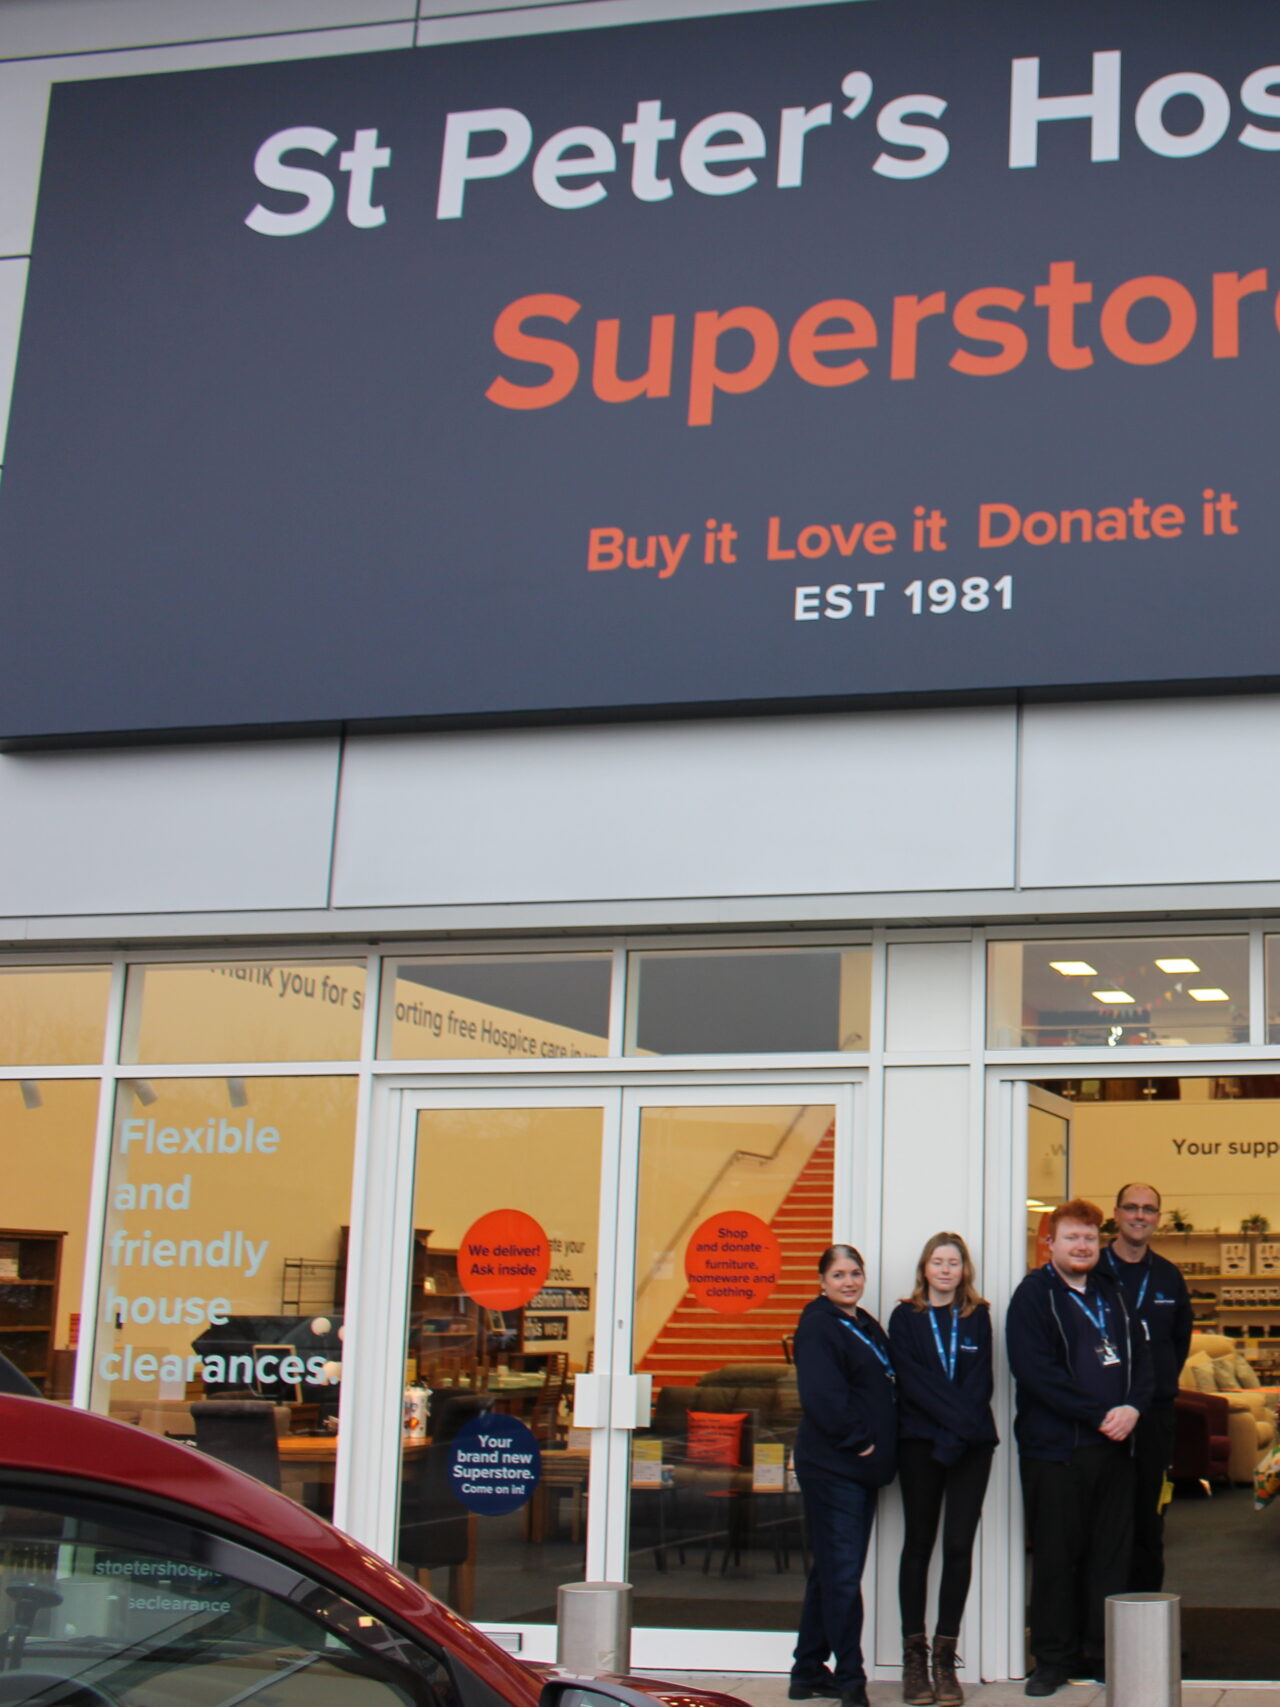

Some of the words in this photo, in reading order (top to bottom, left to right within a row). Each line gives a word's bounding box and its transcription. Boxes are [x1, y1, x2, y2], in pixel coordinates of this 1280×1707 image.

[244, 125, 391, 237] St
[435, 71, 951, 220] Peter’s
[586, 524, 691, 579] Buy
[704, 519, 738, 565] it
[766, 511, 897, 562] Love
[913, 506, 948, 553] it
[978, 496, 1185, 548] Donate
[1201, 489, 1239, 537] it
[794, 582, 885, 622] EST
[903, 574, 1014, 615] 1981
[279, 970, 316, 998] you
[321, 975, 349, 1006] for
[447, 1010, 478, 1040] free
[480, 1018, 537, 1055] Hospice
[119, 1117, 281, 1154] Flexible
[1172, 1138, 1222, 1156] Your
[113, 1174, 192, 1210] and
[717, 1227, 749, 1240] Shop
[109, 1230, 270, 1277] friendly
[468, 1244, 491, 1257] We
[492, 1244, 542, 1257] deliver!
[695, 1242, 719, 1252] and
[720, 1242, 763, 1252] donate
[470, 1263, 495, 1276] Ask
[497, 1263, 538, 1276] inside
[688, 1273, 750, 1283] homeware
[752, 1273, 776, 1284] and
[103, 1286, 233, 1326] house
[97, 1343, 342, 1385] clearances.
[478, 1434, 513, 1449] Your
[456, 1449, 499, 1464] brand
[502, 1453, 533, 1464] new
[452, 1464, 535, 1481] Superstore.
[461, 1483, 494, 1494] Come
[495, 1485, 510, 1495] on
[511, 1484, 526, 1495] in!
